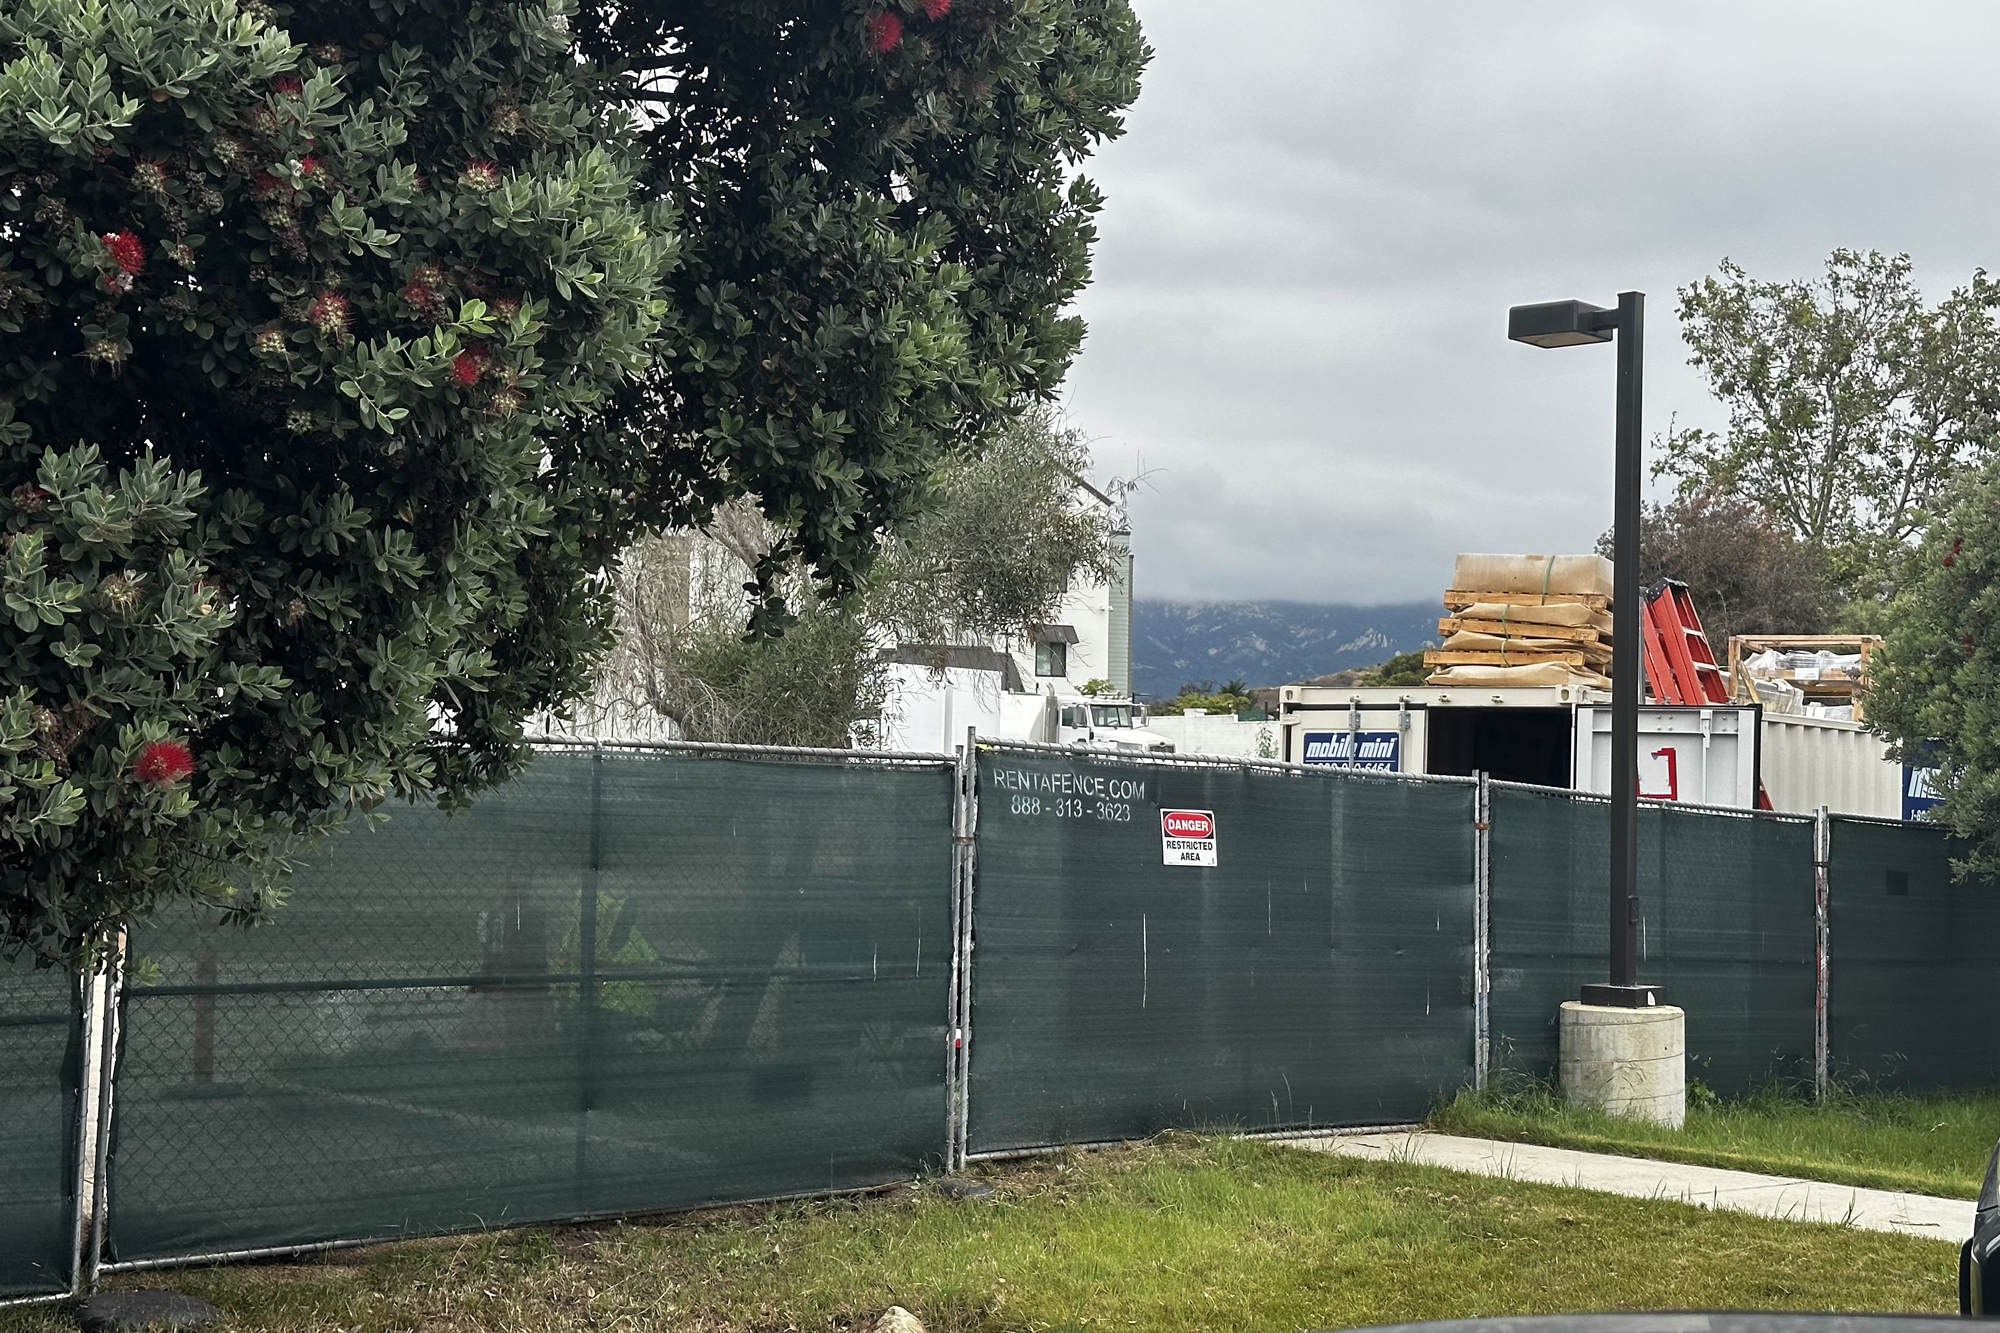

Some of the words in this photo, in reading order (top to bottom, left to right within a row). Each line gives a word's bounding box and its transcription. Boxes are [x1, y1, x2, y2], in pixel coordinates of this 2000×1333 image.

[1358, 738, 1395, 758] mini
[993, 768, 1145, 800] RENTAFENCE.COM
[1011, 794, 1041, 815] 888
[1055, 797, 1083, 818] 313
[1096, 801, 1131, 822] 3623
[1168, 818, 1209, 832] DANGER
[1166, 840, 1213, 851] RESTRICTED
[1180, 852, 1201, 861] AREA
